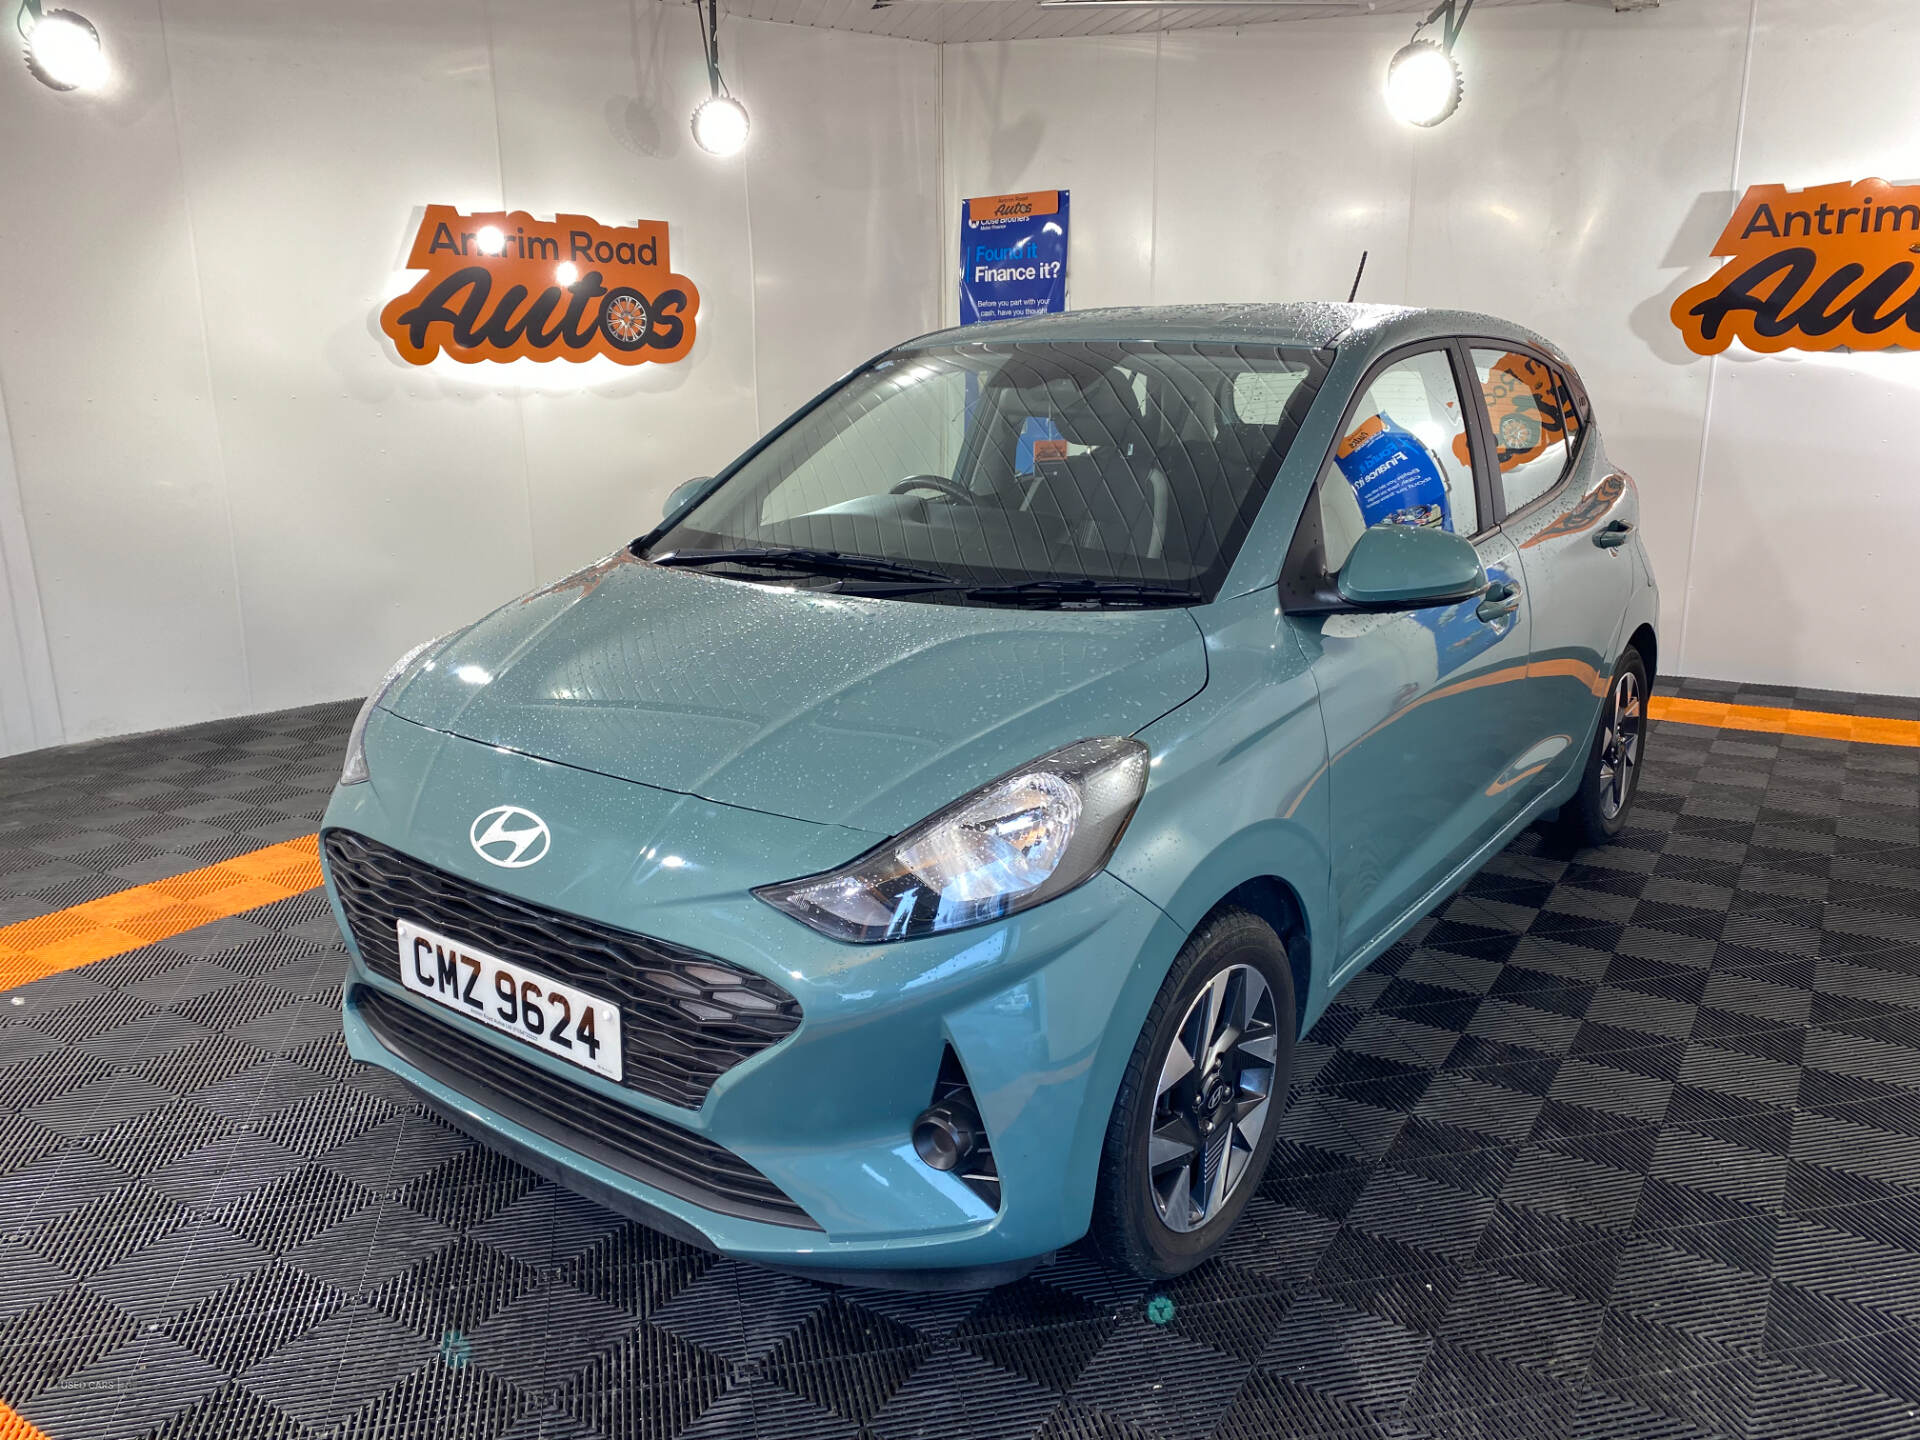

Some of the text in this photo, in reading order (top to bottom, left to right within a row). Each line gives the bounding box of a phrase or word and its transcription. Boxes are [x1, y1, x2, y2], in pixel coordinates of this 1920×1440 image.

[994, 203, 1032, 216] Autos
[1740, 197, 1920, 239] Antrim
[571, 230, 657, 266] Road
[976, 242, 1038, 262] Found it
[975, 261, 1061, 283] Finance it?
[397, 266, 688, 352] Autos
[997, 308, 1012, 316] have
[412, 936, 601, 1061] CMZ 9624
